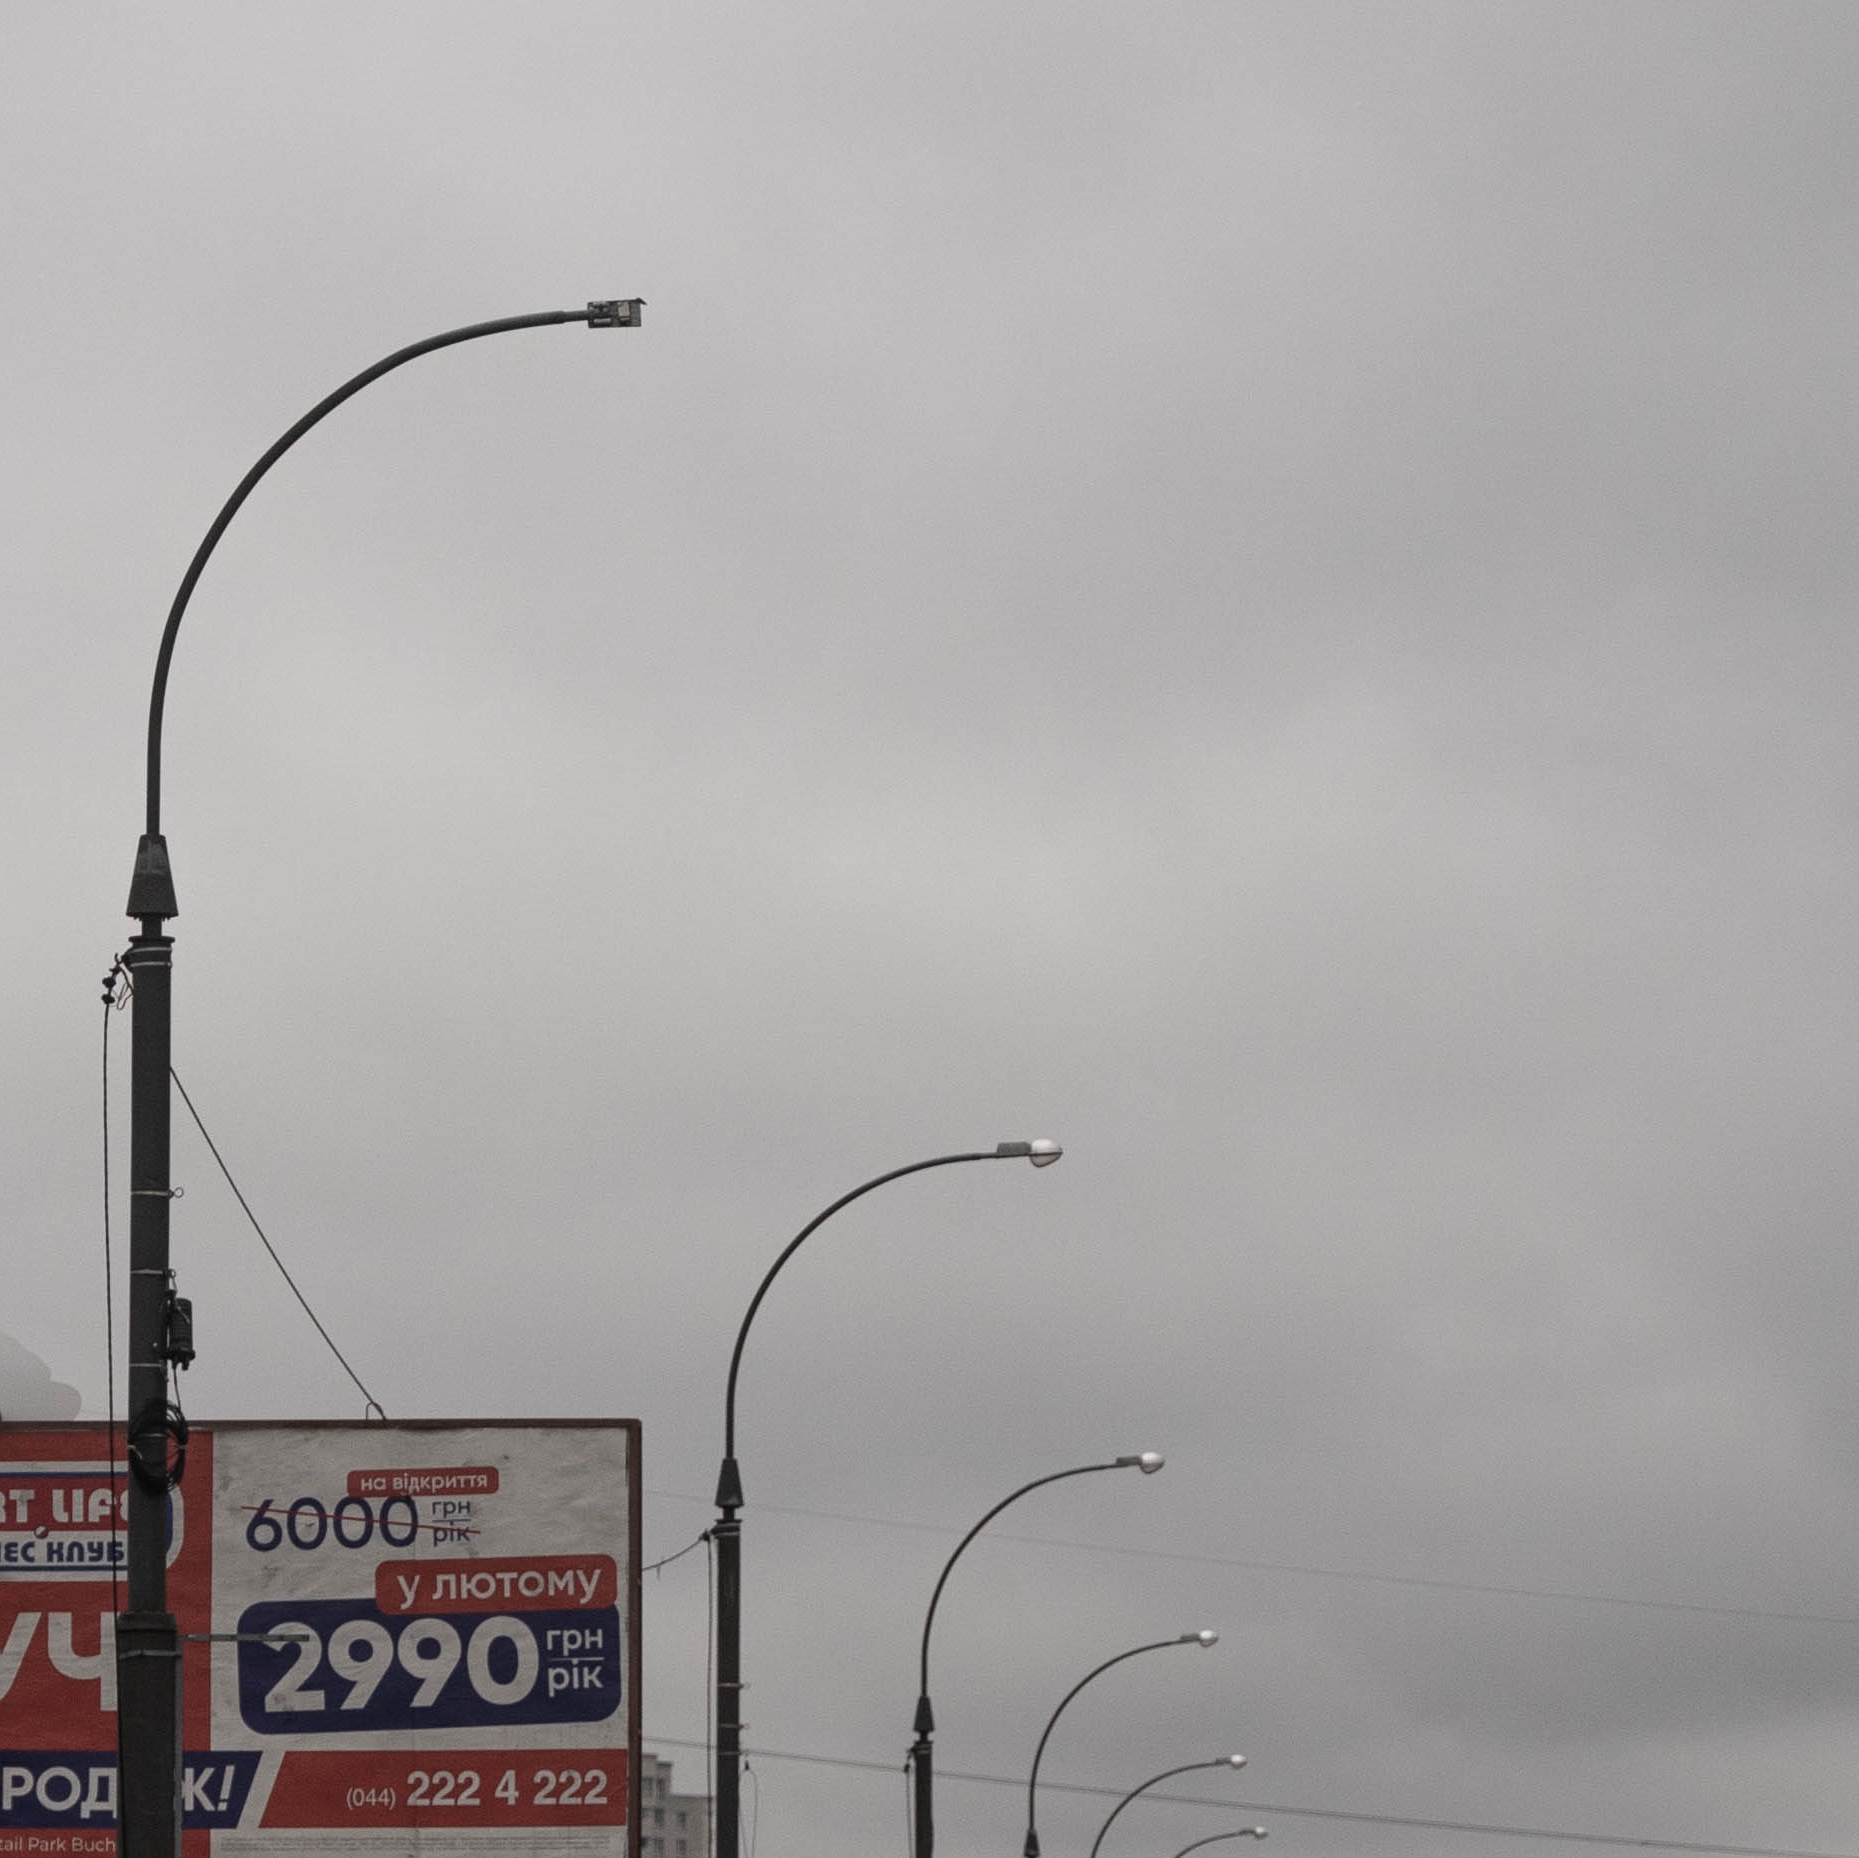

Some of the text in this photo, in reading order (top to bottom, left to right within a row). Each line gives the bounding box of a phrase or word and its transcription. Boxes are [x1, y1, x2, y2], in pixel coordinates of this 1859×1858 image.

[360, 1471, 487, 1494] на відкриття
[246, 1495, 471, 1551] 6000 грн
[432, 1525, 471, 1547] рік
[46, 1541, 125, 1563] КЛУБ
[397, 1568, 601, 1610] у лютому
[263, 1615, 603, 1713] 2990 грн
[546, 1662, 604, 1697] рік
[345, 1768, 607, 1811] (044) 222 4 222
[28, 1837, 65, 1852] Park
[72, 1836, 116, 1852] Buch
